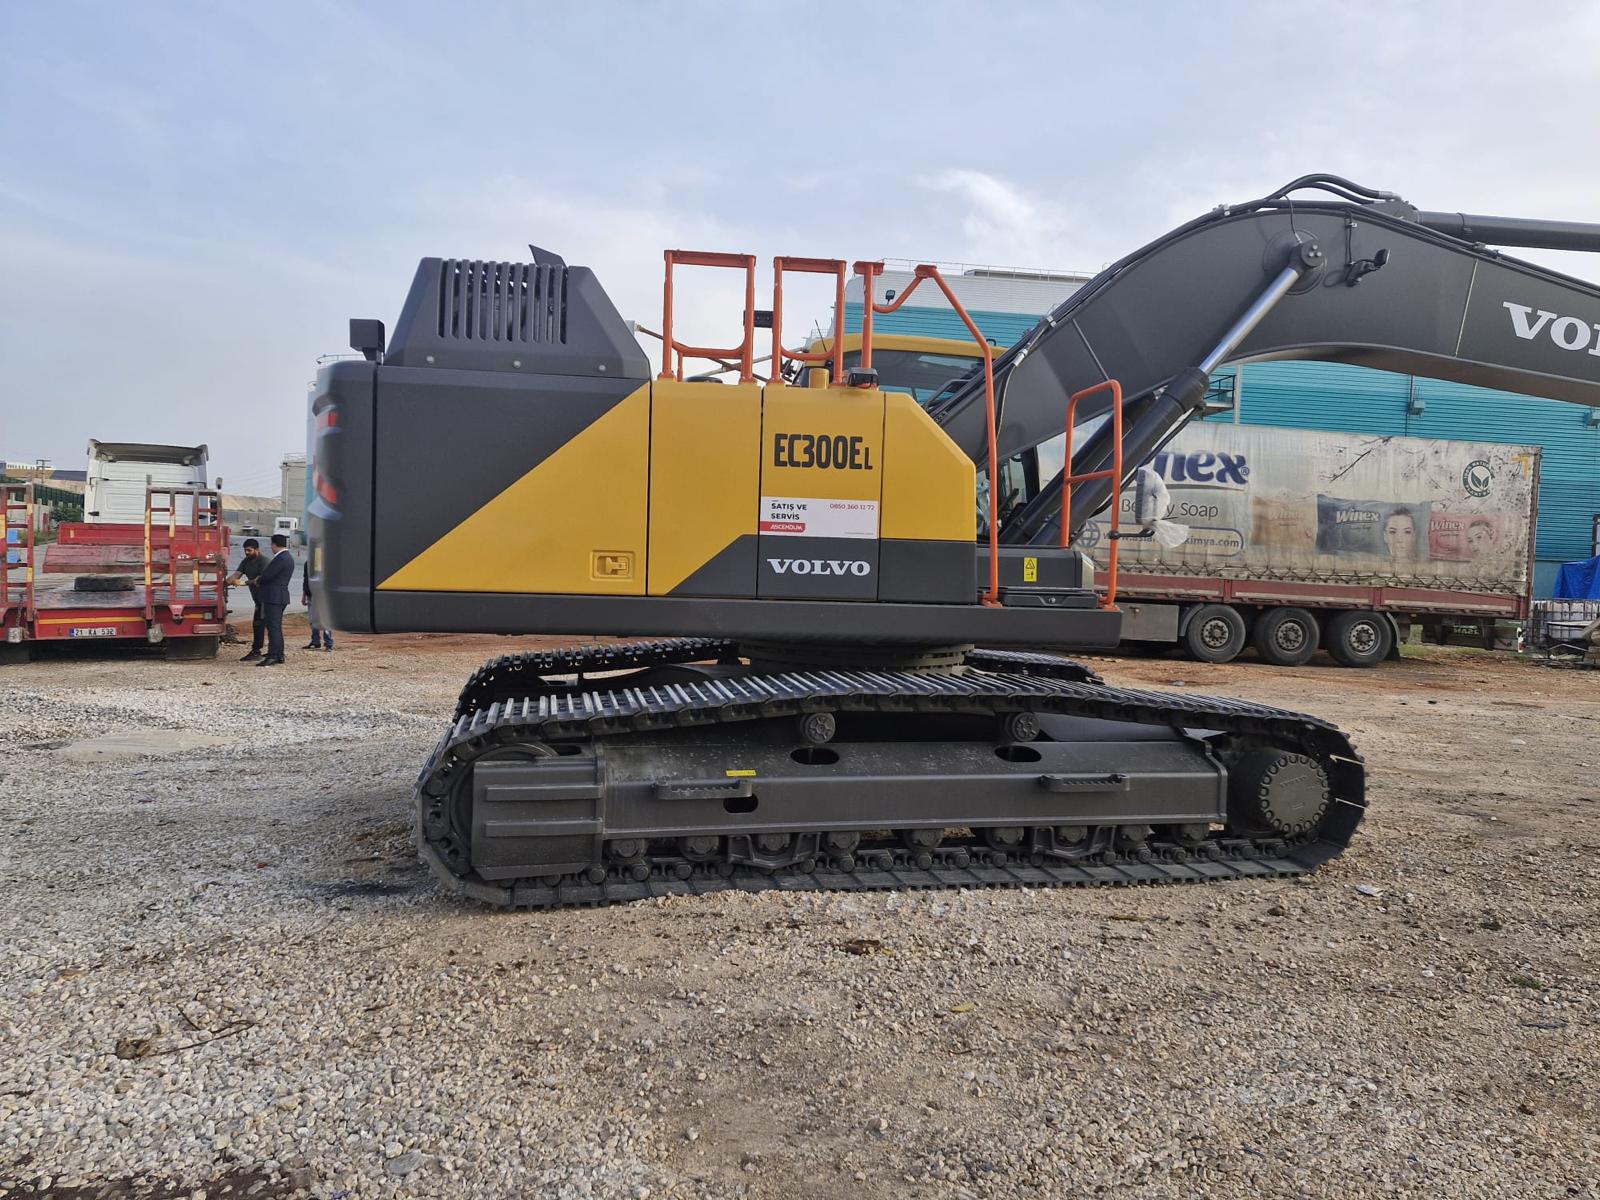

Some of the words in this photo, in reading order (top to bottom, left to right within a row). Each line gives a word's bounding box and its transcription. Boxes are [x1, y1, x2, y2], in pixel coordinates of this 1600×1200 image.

[771, 503, 794, 511] SATIŞ
[1180, 502, 1219, 519] Soap
[1335, 507, 1380, 523] Winex
[1430, 519, 1465, 531] Winex
[766, 558, 871, 576] VOLVO
